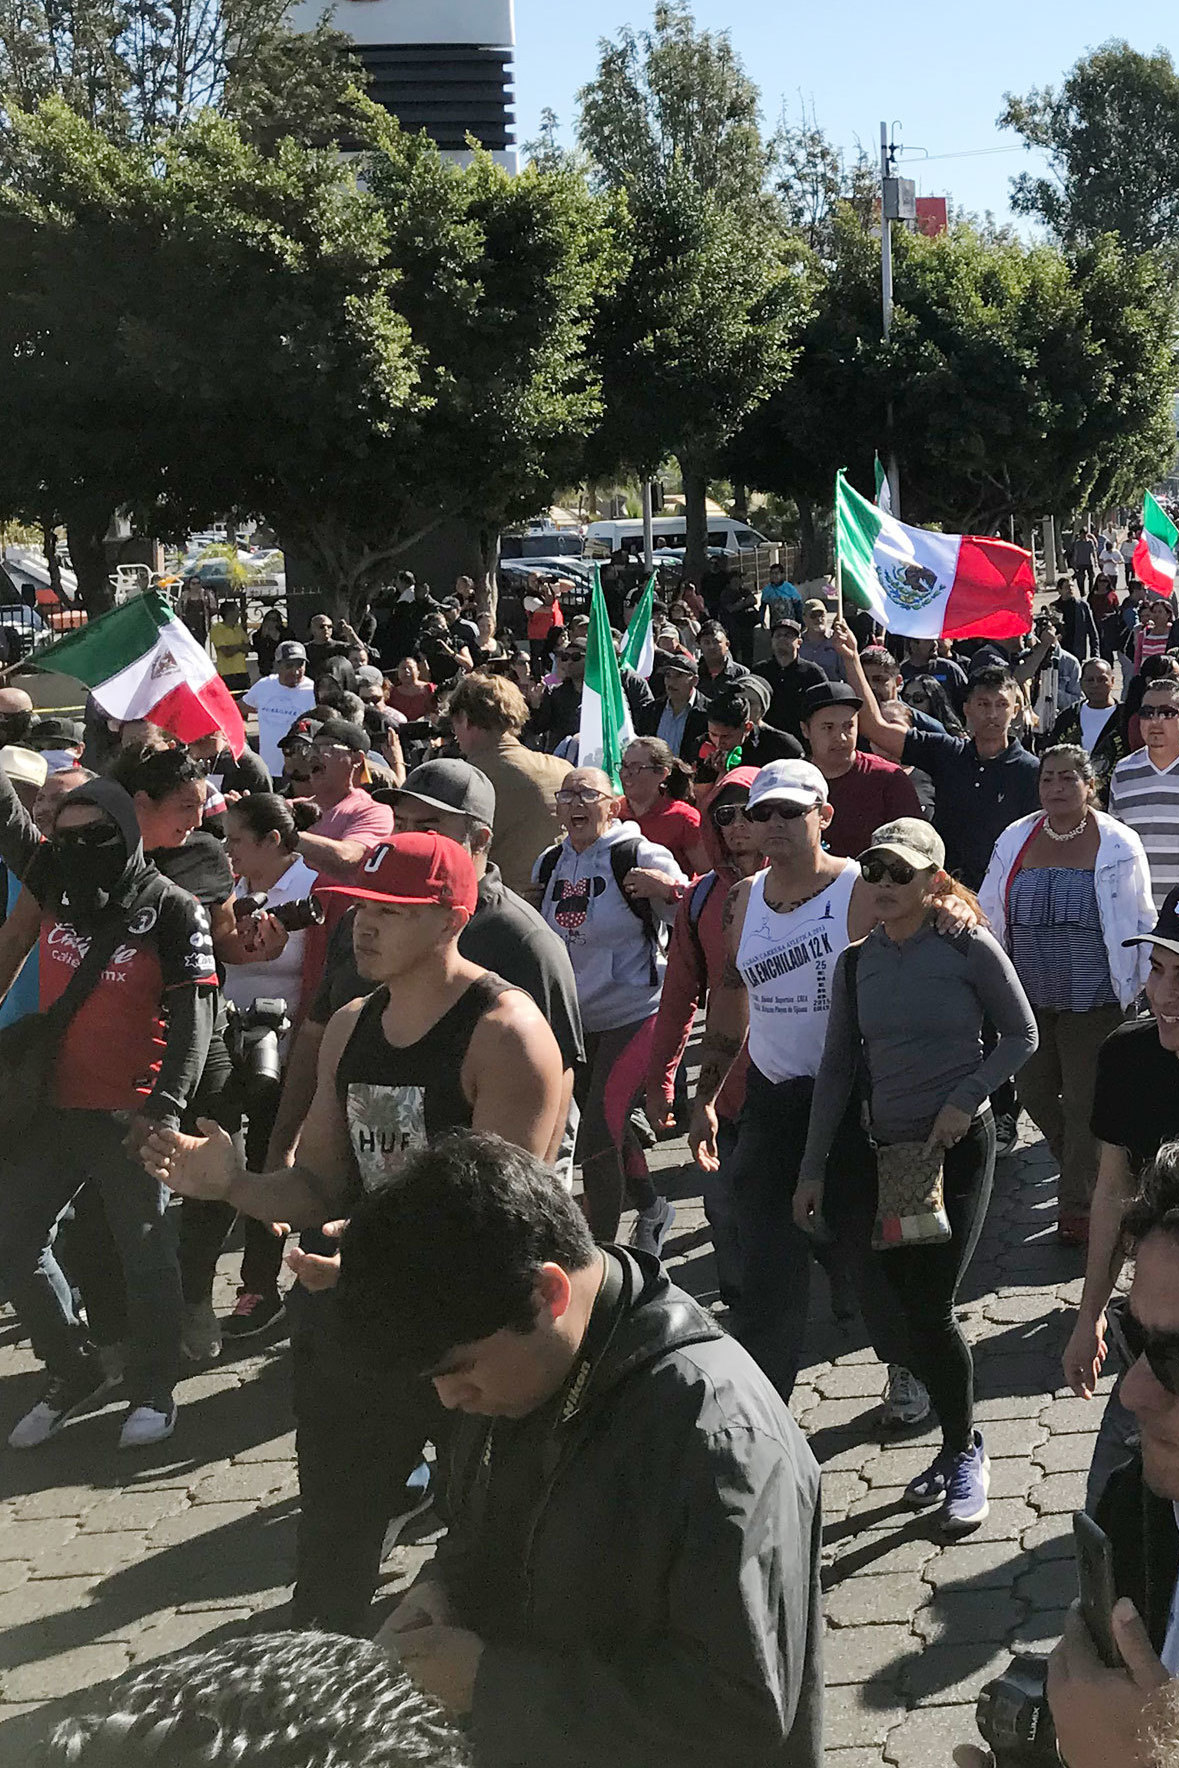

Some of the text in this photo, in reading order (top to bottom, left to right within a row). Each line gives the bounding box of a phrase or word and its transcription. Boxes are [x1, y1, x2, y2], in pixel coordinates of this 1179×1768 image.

[744, 932, 833, 988] LA ENCHILADA 12 K
[815, 960, 827, 970] 25
[563, 1361, 591, 1416] Nikon
[1027, 1707, 1041, 1741] LUMIX
